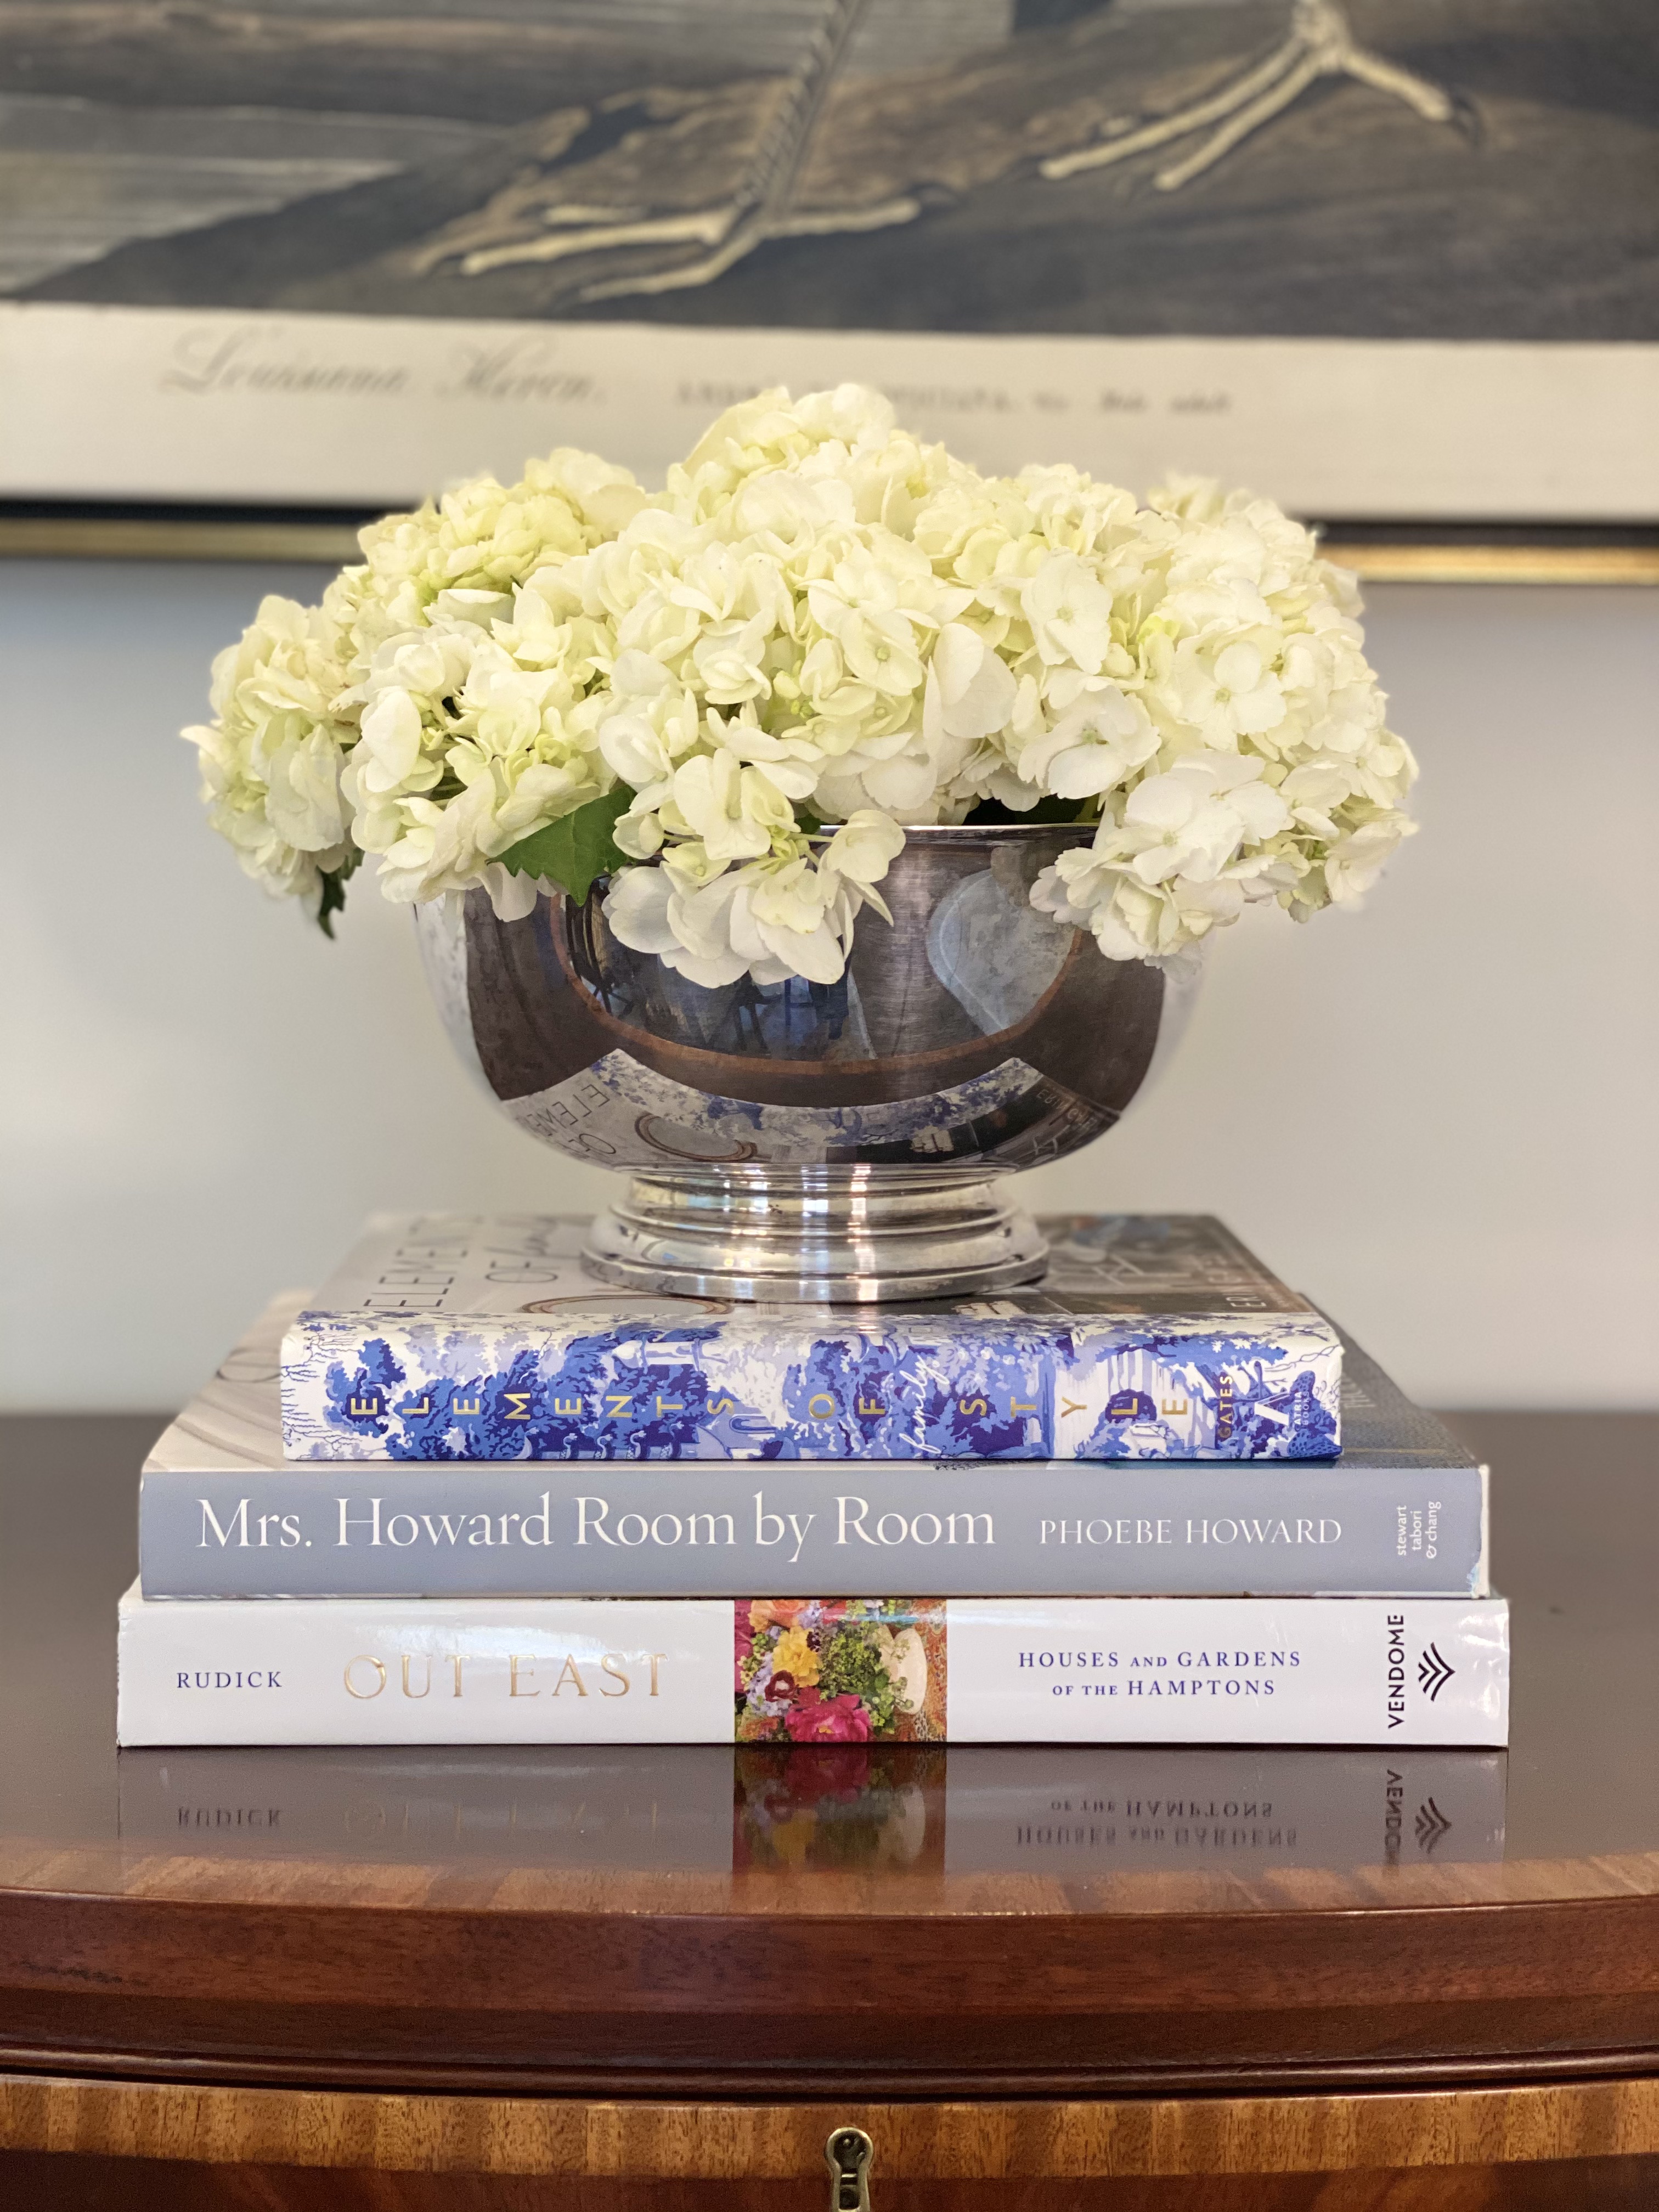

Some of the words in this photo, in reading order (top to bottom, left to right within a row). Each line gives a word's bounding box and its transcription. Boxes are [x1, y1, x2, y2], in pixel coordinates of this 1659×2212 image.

[351, 1392, 735, 1420] ELEMENTS
[809, 1393, 885, 1420] OF
[900, 1352, 950, 1454] family
[960, 1396, 1189, 1419] STYLE
[1218, 1375, 1234, 1439] GATES
[1294, 1391, 1302, 1425] ATRIA
[196, 1499, 313, 1548] Mrs.
[332, 1490, 555, 1547] Howard
[573, 1496, 739, 1547] Room
[753, 1491, 816, 1562] by
[833, 1496, 996, 1547] Room
[1039, 1520, 1172, 1544] PHOEBE
[1186, 1518, 1342, 1544] HOWARD
[1397, 1504, 1407, 1556] stewart
[1410, 1510, 1421, 1551] tabori
[1425, 1500, 1441, 1542] chang
[1426, 1544, 1437, 1559] &
[176, 1671, 283, 1689] RUDICK
[343, 1654, 470, 1699] OUT
[509, 1652, 669, 1697] EAST
[1019, 1651, 1120, 1668] HOUSES
[1130, 1657, 1168, 1667] AND
[1177, 1651, 1301, 1668] GARDENS
[1387, 1614, 1405, 1729] VENDOME
[1052, 1685, 1073, 1696] OF
[1082, 1685, 1118, 1696] THE
[1127, 1680, 1276, 1696] HAMPTONS
